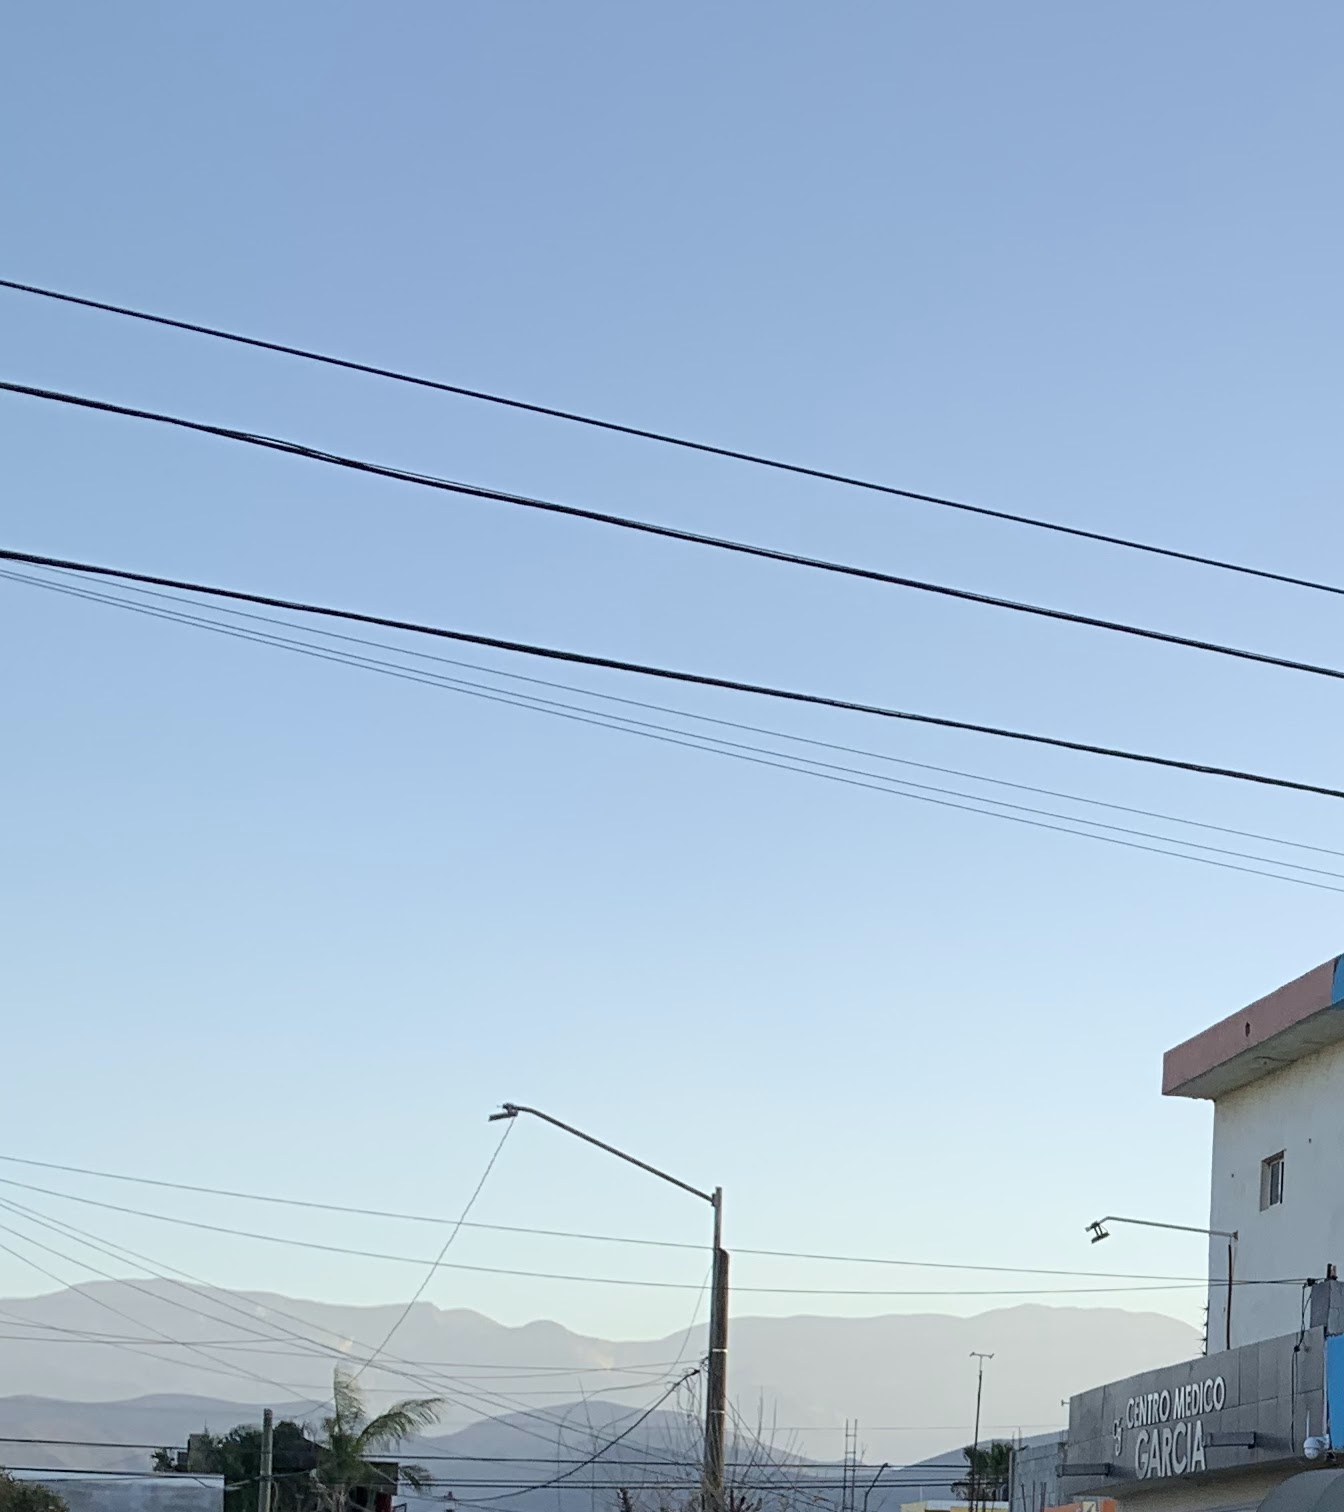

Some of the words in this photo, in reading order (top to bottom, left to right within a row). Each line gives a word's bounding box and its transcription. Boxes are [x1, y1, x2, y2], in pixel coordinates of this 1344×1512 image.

[1126, 1389, 1171, 1428] CENTRO
[1173, 1376, 1226, 1421] MEDICO
[1135, 1420, 1207, 1480] GARCIA
